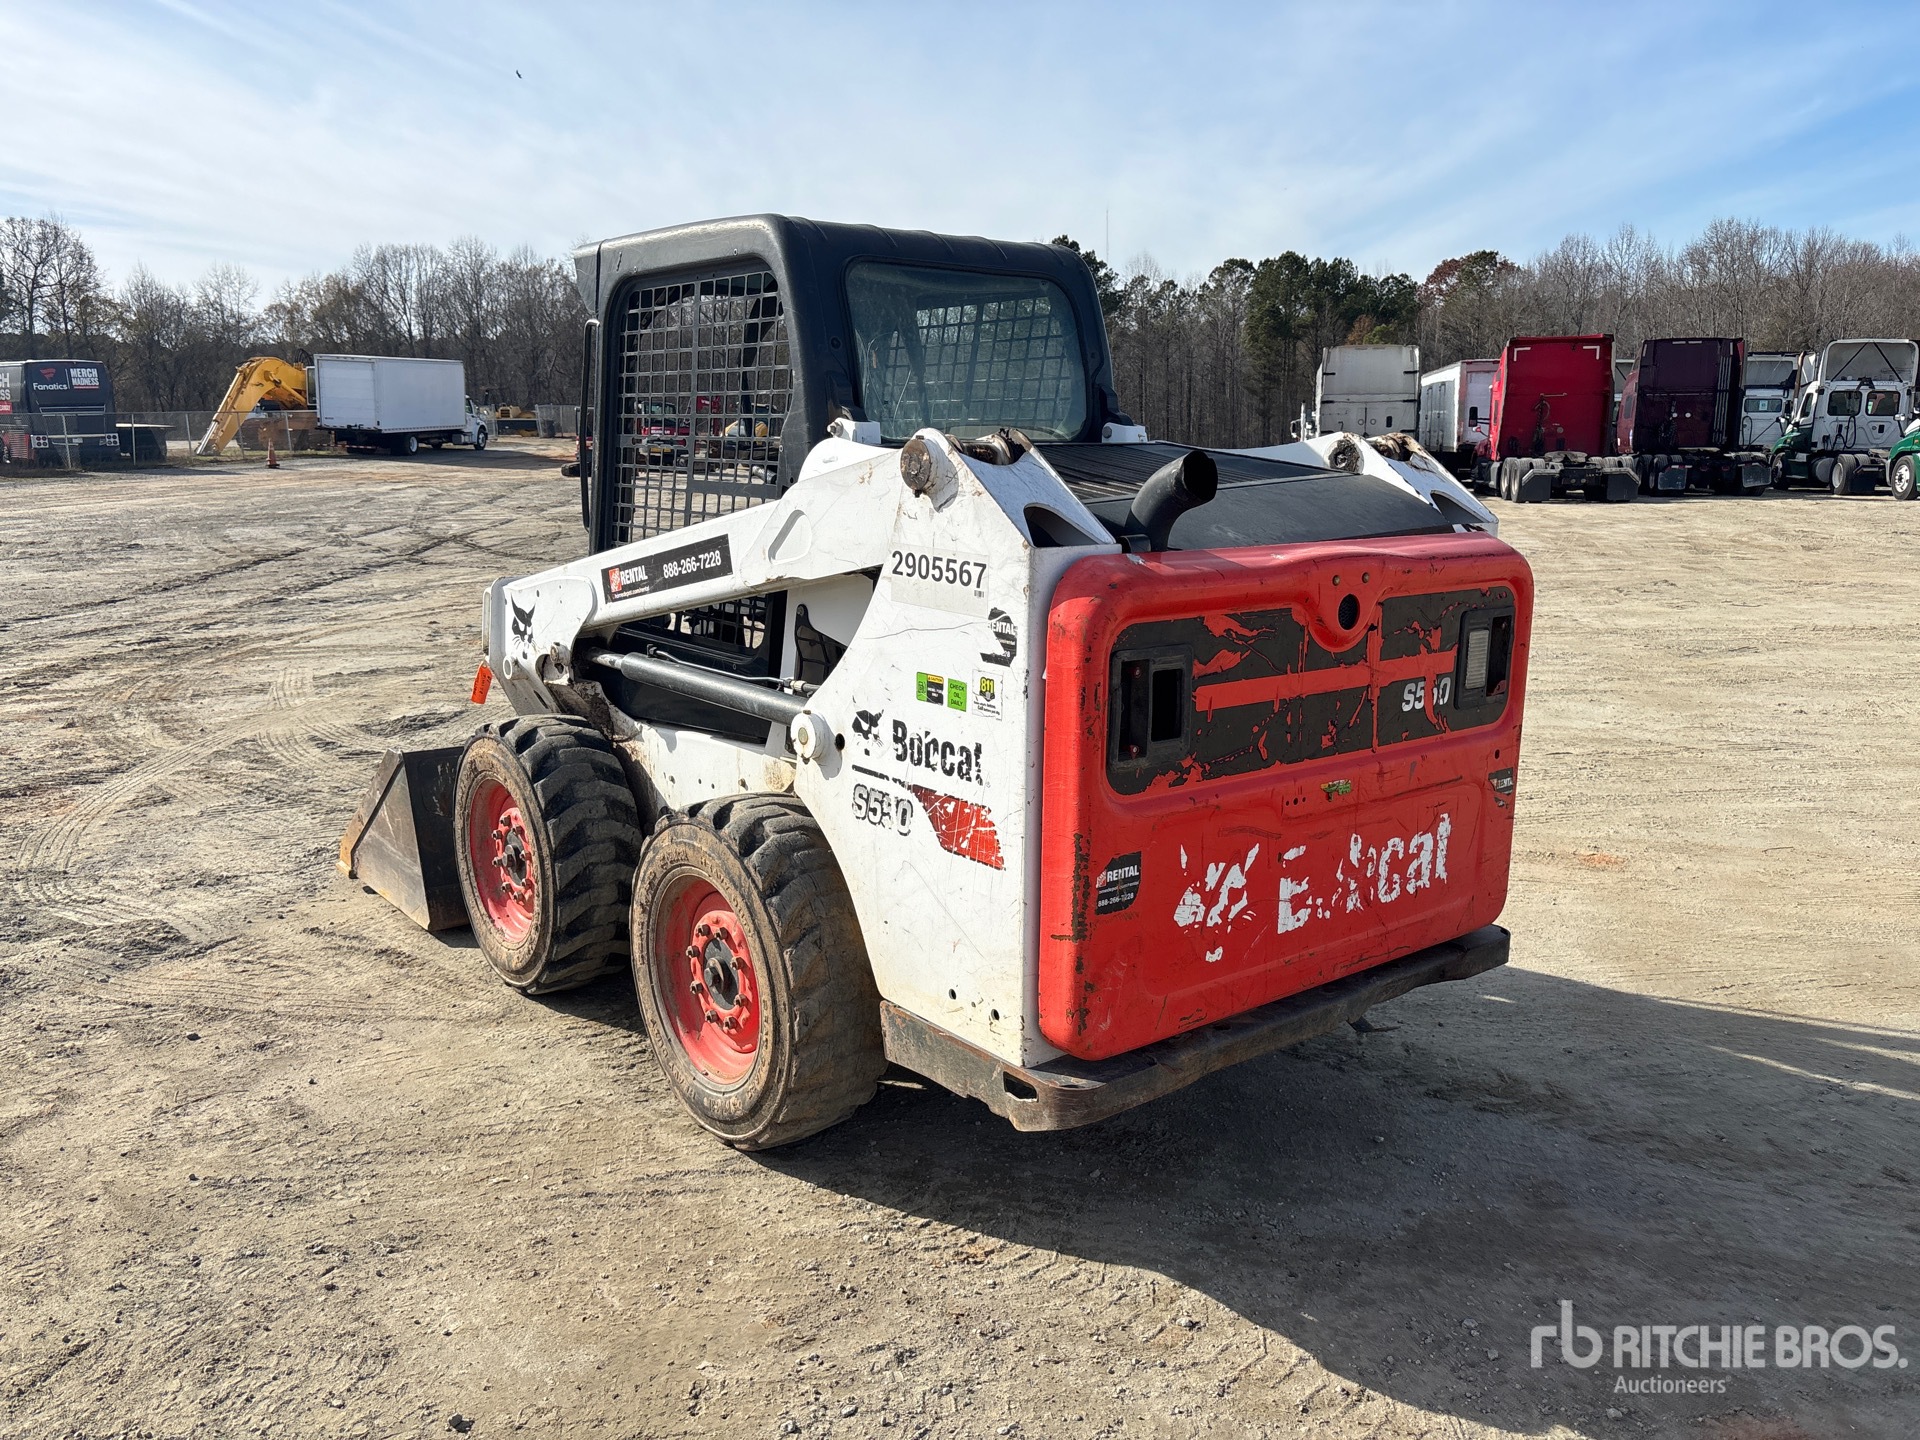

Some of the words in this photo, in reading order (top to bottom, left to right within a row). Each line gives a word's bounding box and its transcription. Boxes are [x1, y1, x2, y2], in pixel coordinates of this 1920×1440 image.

[70, 368, 98, 378] MERCH
[33, 382, 68, 390] Fanatics
[71, 377, 99, 386] MADNESS
[620, 565, 648, 585] RENTAL
[662, 549, 722, 578] 888-266-7228
[891, 550, 987, 589] 2905567
[949, 683, 965, 692] CHECK
[980, 676, 995, 693] 811
[953, 691, 961, 699] OIL
[950, 699, 963, 707] DAILY
[892, 719, 984, 786] Bobcat
[1106, 864, 1140, 883] RENTAL
